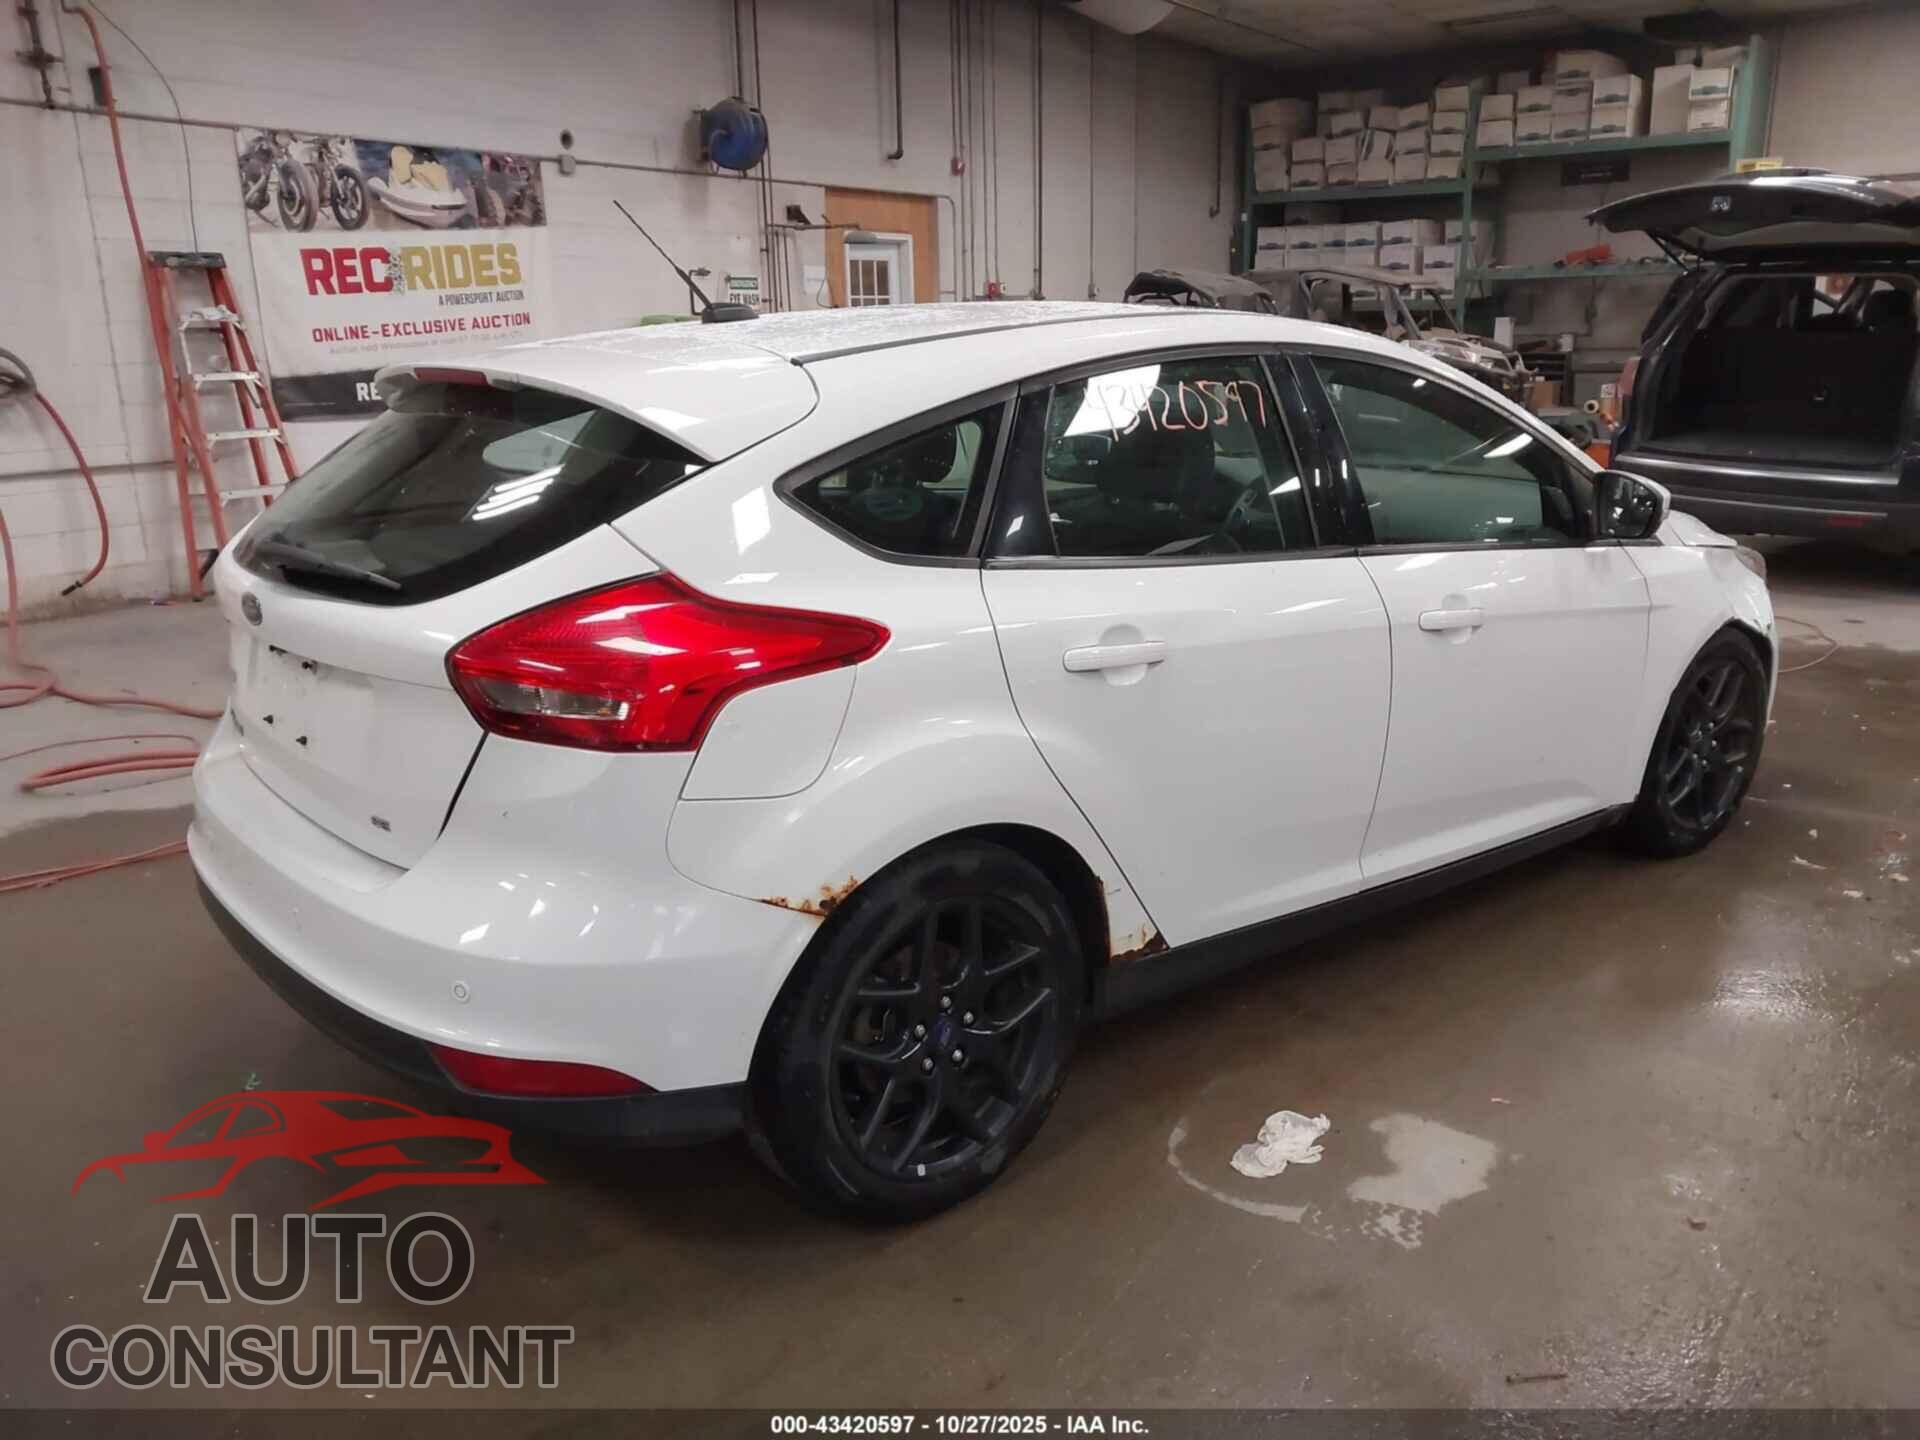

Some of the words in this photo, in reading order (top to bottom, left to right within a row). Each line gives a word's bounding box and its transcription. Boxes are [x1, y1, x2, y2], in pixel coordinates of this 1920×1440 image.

[300, 246, 394, 295] REC
[401, 243, 522, 290] RIDES
[438, 295, 445, 307] A
[445, 291, 493, 306] POWERSPORT
[495, 289, 525, 302] AUCTION
[312, 317, 466, 343] ONLINE-EXCLUSIVE
[471, 312, 531, 331] AUCTION
